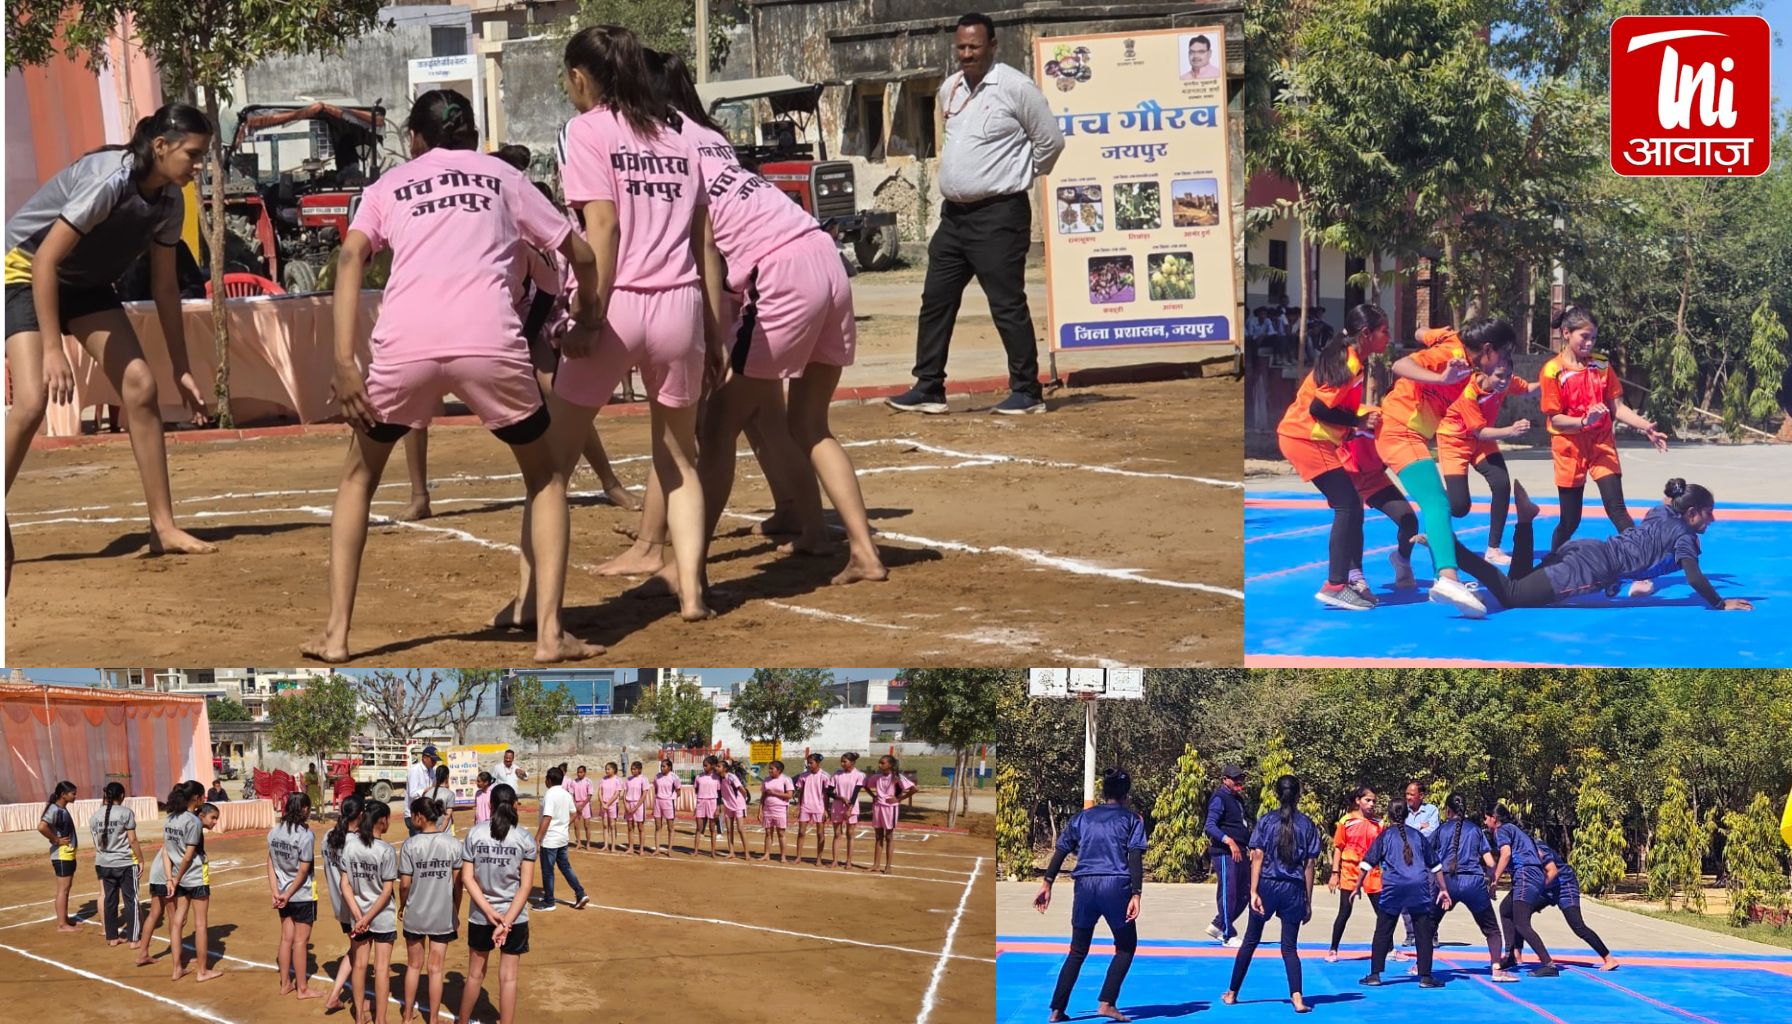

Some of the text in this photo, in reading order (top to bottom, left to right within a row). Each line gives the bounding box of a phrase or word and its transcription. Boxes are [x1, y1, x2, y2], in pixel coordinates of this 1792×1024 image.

[1056, 99, 1219, 136] पंच गौरव
[611, 146, 640, 172] पंच
[1100, 143, 1169, 163] जयपुर
[393, 168, 502, 201] पंच गौरव
[624, 180, 683, 203] जयपुर
[706, 172, 737, 197] पंच
[410, 193, 493, 217] जयपुर
[1074, 323, 1214, 341] जिला प्रशासन, जयपुर
